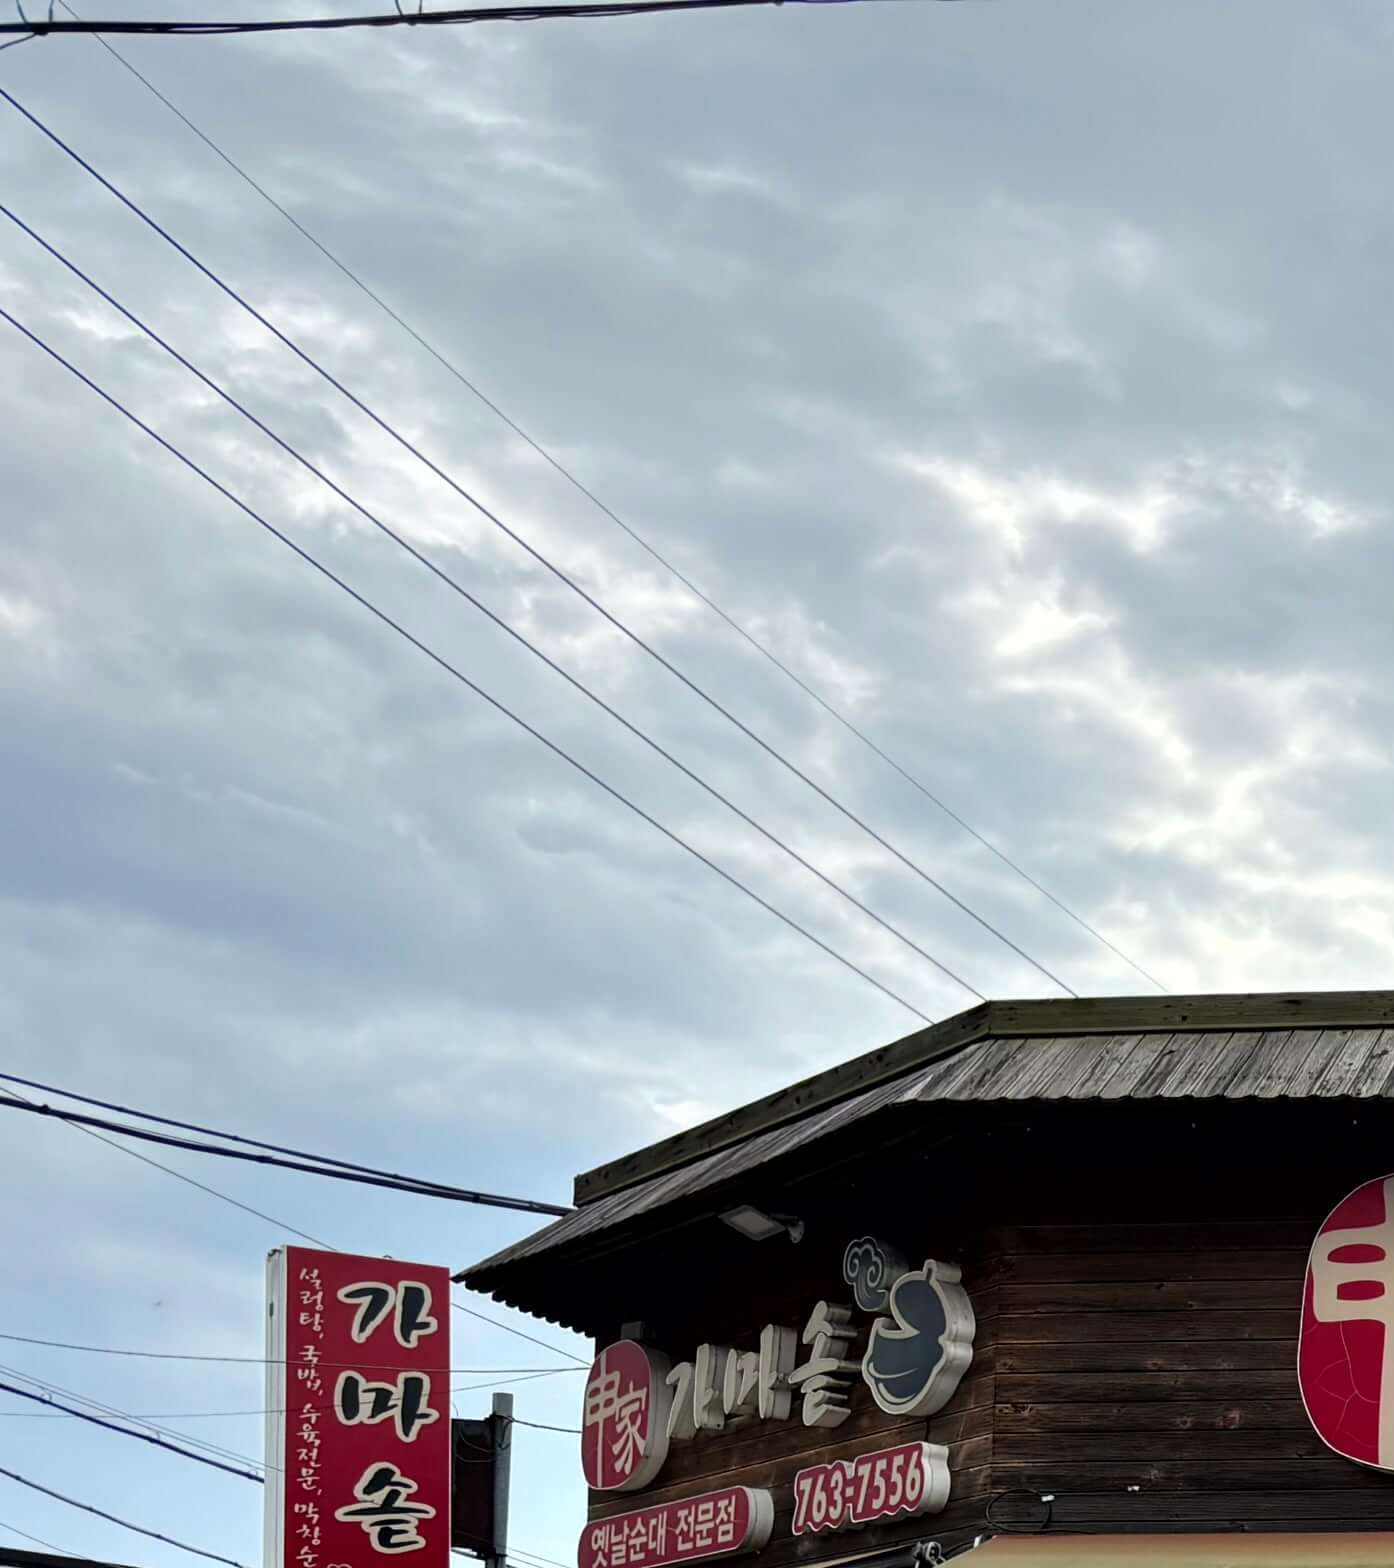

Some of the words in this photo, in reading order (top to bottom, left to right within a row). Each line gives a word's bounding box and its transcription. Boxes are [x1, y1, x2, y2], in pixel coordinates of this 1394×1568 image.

[333, 1280, 440, 1554] 가마솥
[666, 1300, 850, 1440] 가마솥
[675, 1494, 737, 1553] 전문점
[796, 1449, 923, 1528] 763-7556
